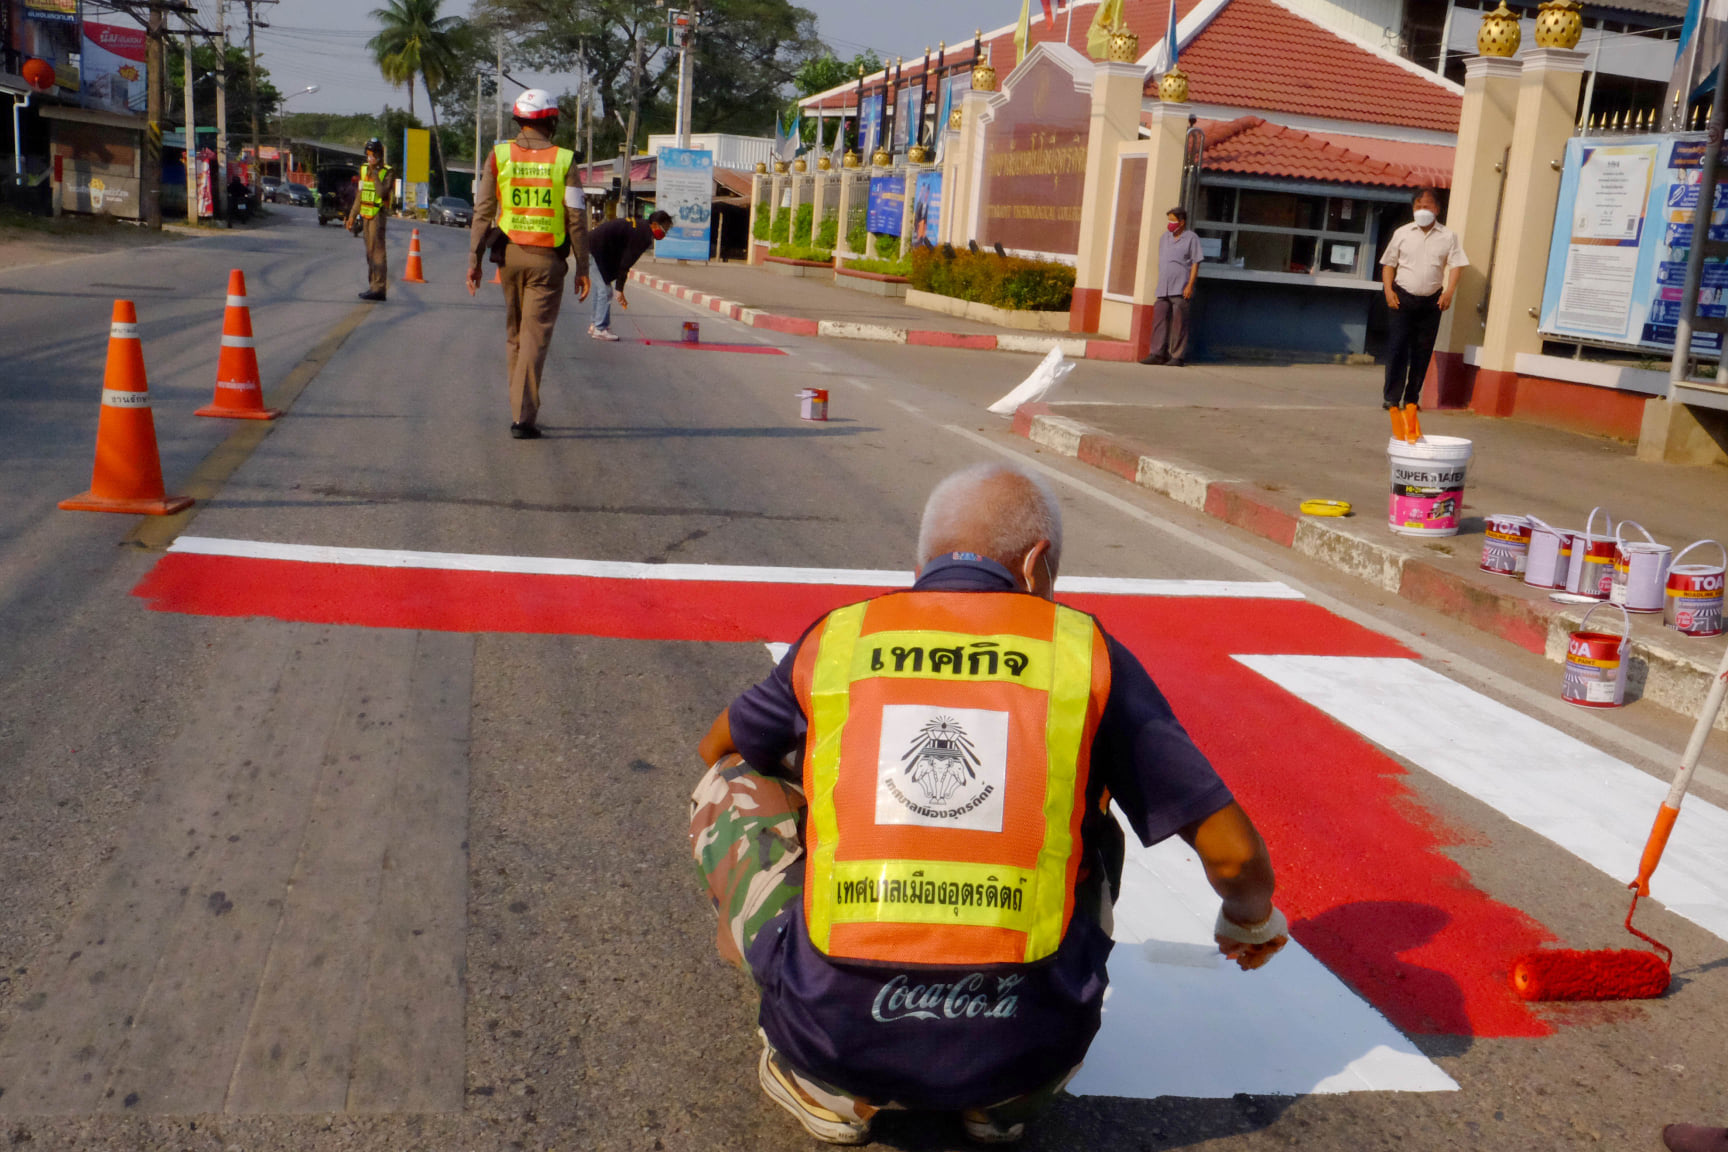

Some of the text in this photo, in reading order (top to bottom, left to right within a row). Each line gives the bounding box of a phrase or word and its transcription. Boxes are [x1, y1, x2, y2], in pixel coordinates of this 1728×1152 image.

[512, 188, 552, 207] 6114
[1492, 519, 1521, 536] TOA
[1691, 575, 1723, 591] TOA
[870, 641, 1030, 677] เทศกิจ
[884, 776, 996, 820] เทศบาลเมืองอุตรดิตถ์
[836, 869, 1028, 917] เทศบาลเมืองอุตรดิตถ์
